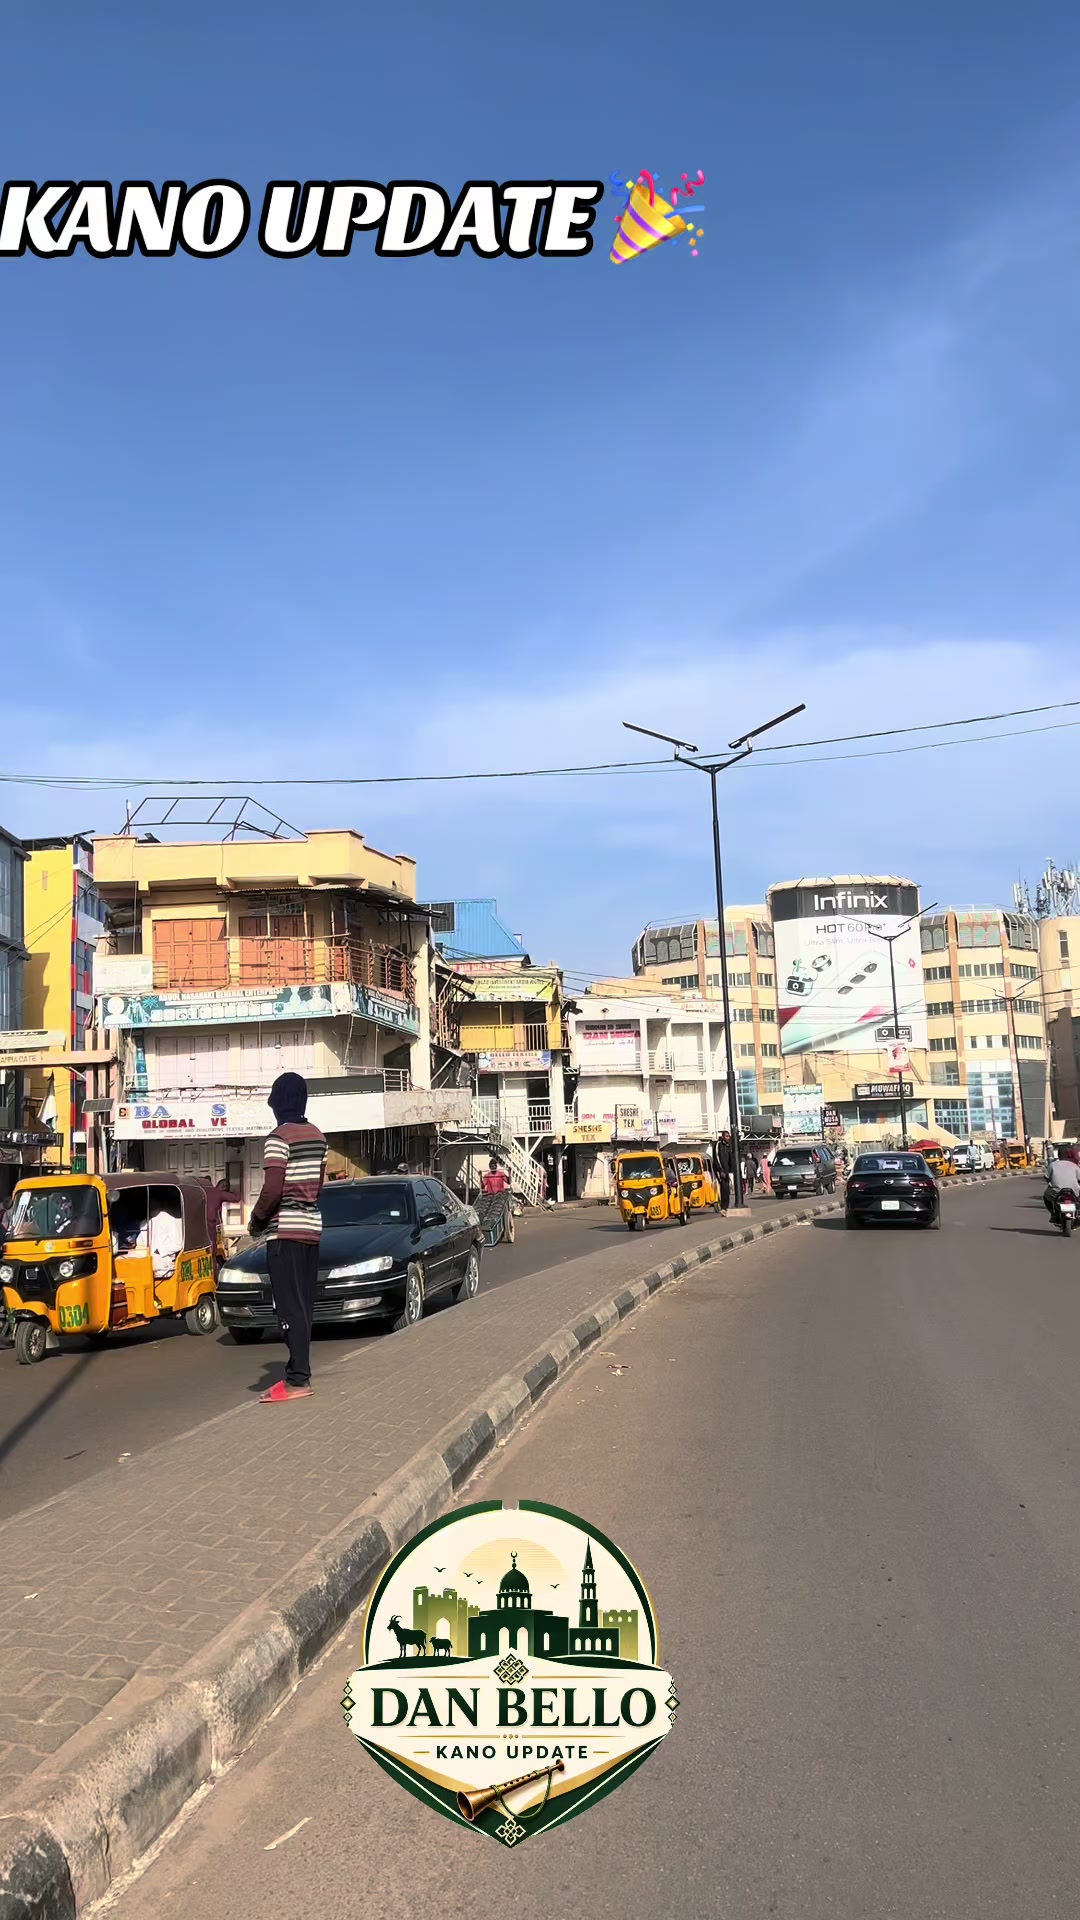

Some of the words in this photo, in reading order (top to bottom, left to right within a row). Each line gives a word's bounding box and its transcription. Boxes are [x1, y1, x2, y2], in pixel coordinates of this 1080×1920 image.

[814, 891, 888, 911] Infinix
[816, 924, 845, 934] HOT
[620, 1108, 639, 1117] SHESHE
[141, 1118, 195, 1129] GLOBAL
[623, 1119, 635, 1128] TEX
[573, 1125, 602, 1134] SHESHE
[581, 1134, 596, 1142] TEX
